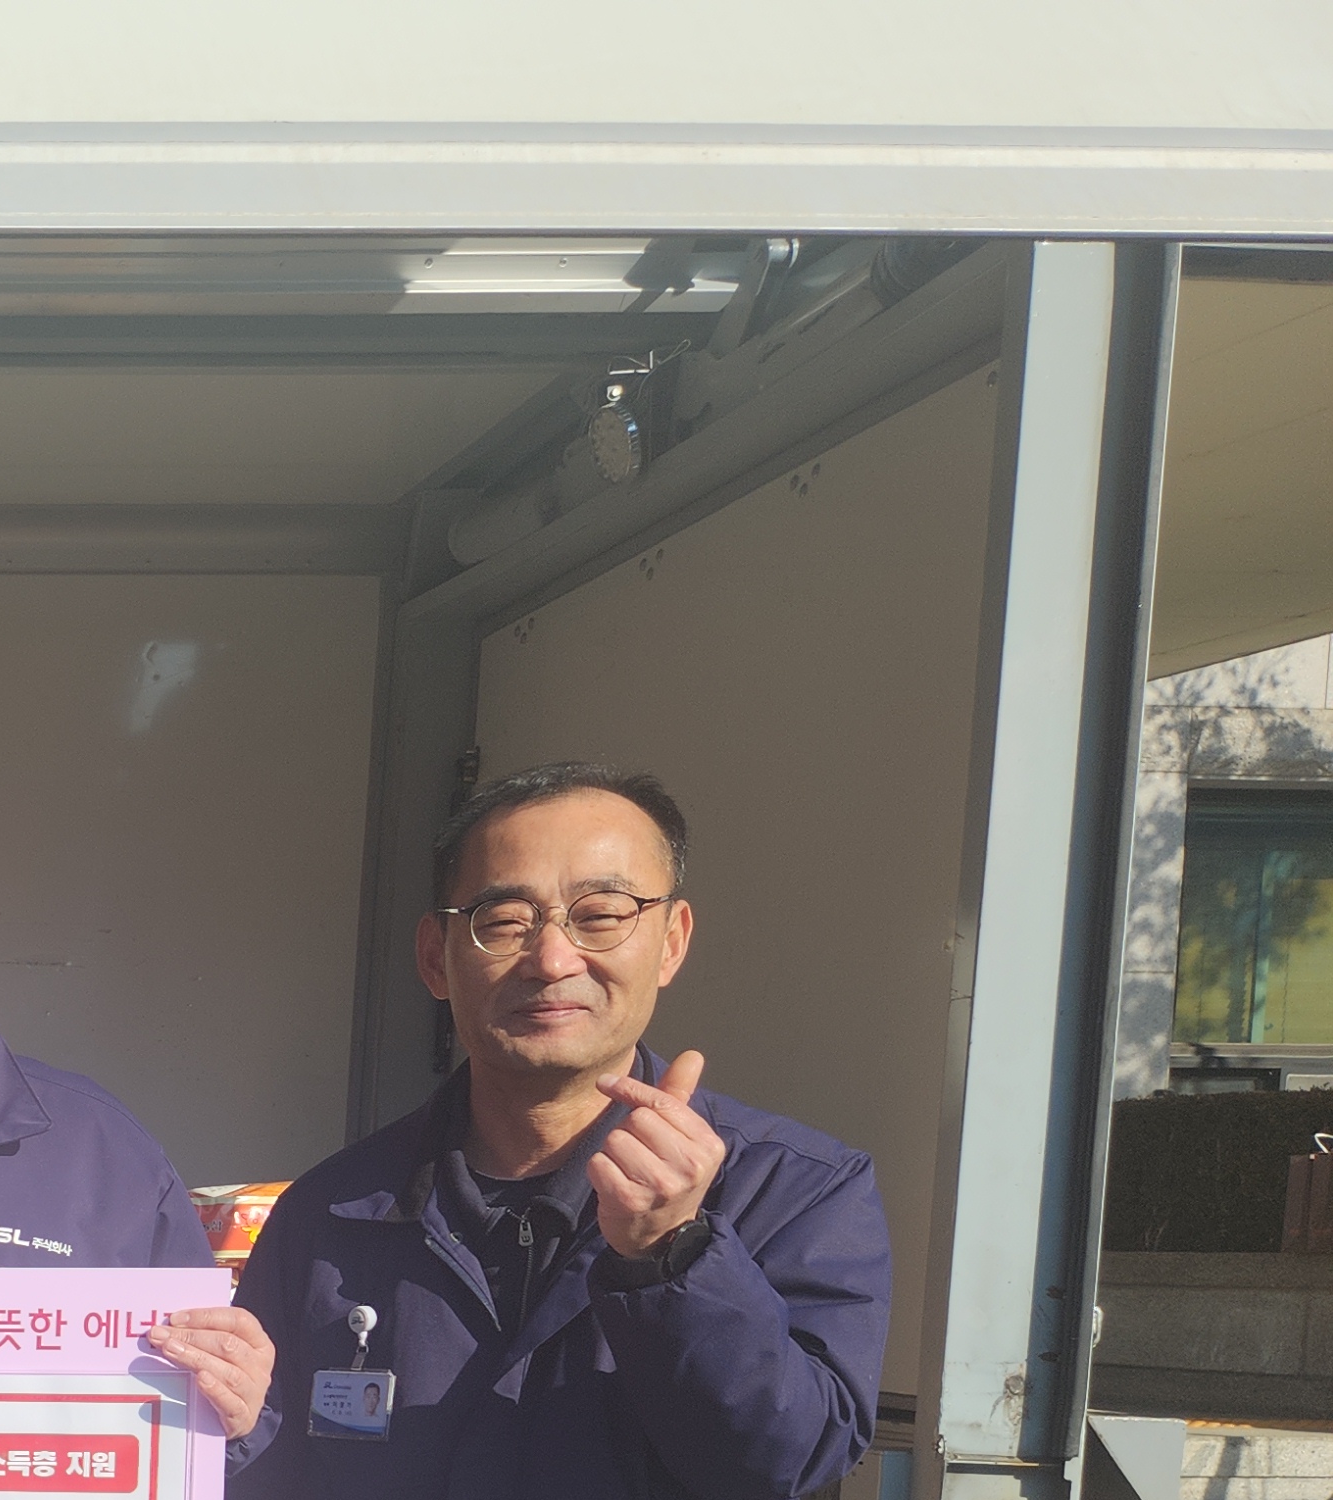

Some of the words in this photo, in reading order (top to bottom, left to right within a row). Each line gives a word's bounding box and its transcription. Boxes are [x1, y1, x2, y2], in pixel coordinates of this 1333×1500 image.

[32, 1236, 73, 1257] 주식회사
[82, 1309, 173, 1349] 에너
[65, 1451, 117, 1479] 지원
